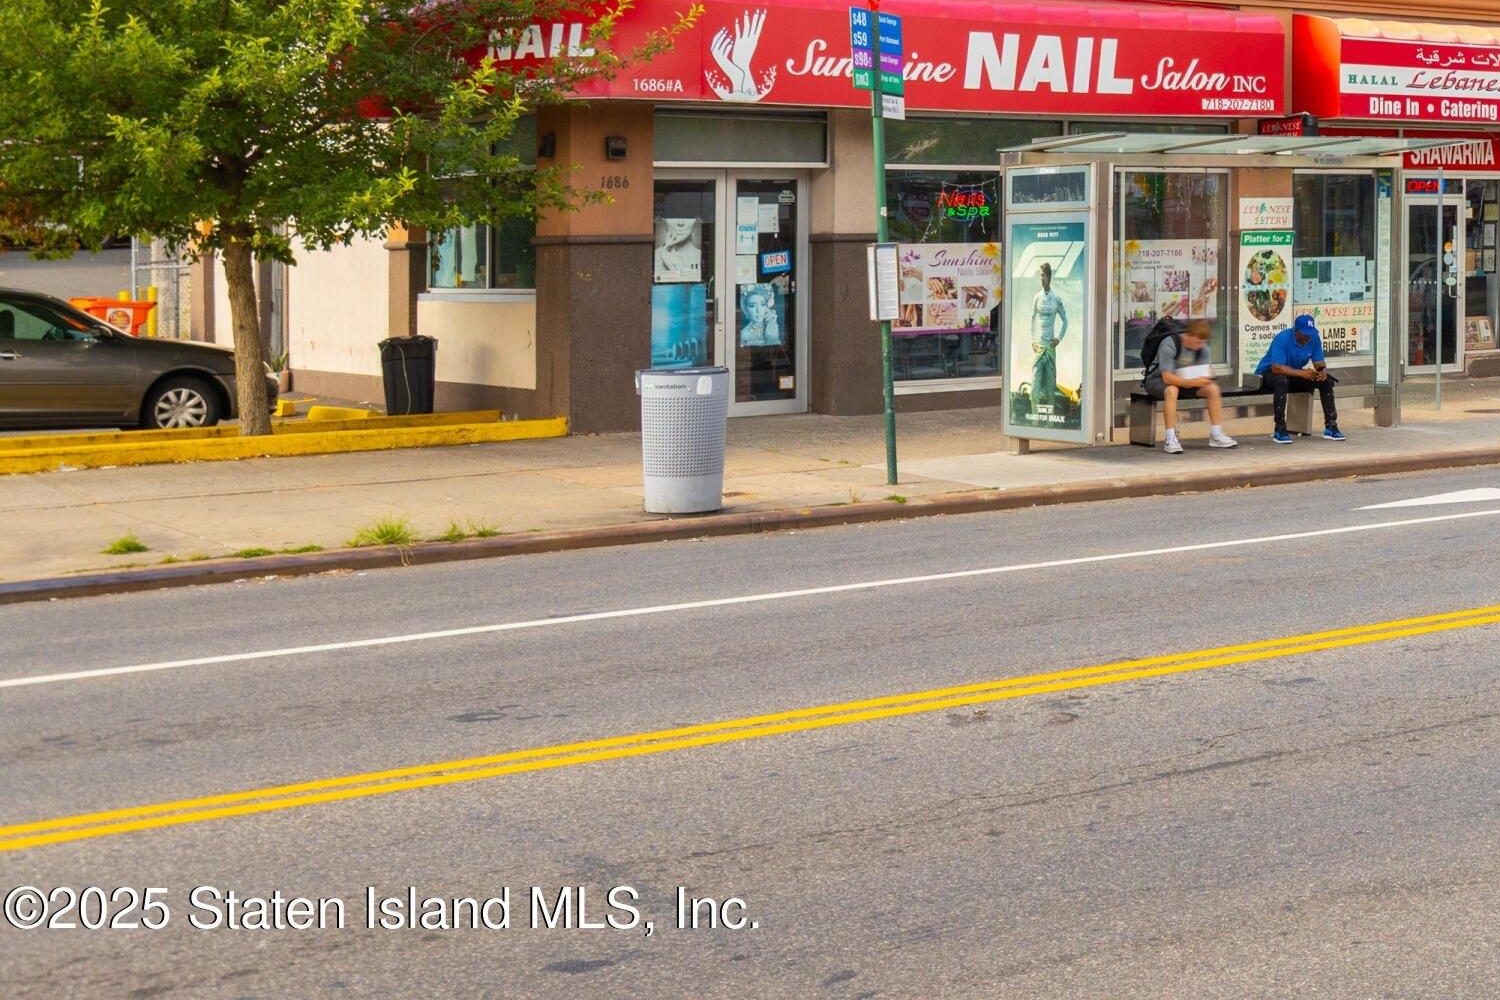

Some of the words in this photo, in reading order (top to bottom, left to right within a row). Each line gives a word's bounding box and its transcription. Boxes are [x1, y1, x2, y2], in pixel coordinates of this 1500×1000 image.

[852, 12, 867, 26] S48
[488, 23, 595, 61] NAIL
[853, 31, 868, 46] S59
[786, 39, 957, 82] Sunine
[963, 31, 1134, 95] NAIL
[1141, 57, 1230, 91] Salon
[1232, 75, 1266, 93] INC
[854, 51, 868, 67] S98
[632, 78, 684, 92] 1686#A
[1347, 74, 1399, 86] HALAL
[1205, 99, 1272, 111] 718-207-7180
[1369, 97, 1402, 115] Dine
[1406, 98, 1420, 116] In
[1440, 99, 1498, 120] Catering
[1410, 139, 1495, 166] SHAWARMA
[600, 175, 630, 190] 1686
[935, 189, 986, 208] Nails
[1244, 234, 1271, 244] Platter
[1272, 233, 1283, 243] for
[1285, 233, 1291, 242] 2
[764, 253, 787, 268] OPEN
[928, 249, 994, 268] Sunshine
[1244, 323, 1271, 332] Comes
[1271, 322, 1288, 331] with
[1322, 327, 1346, 339] LAMB
[1251, 332, 1257, 340] 2
[1322, 339, 1357, 351] BURGER
[654, 382, 686, 390] sanitation
